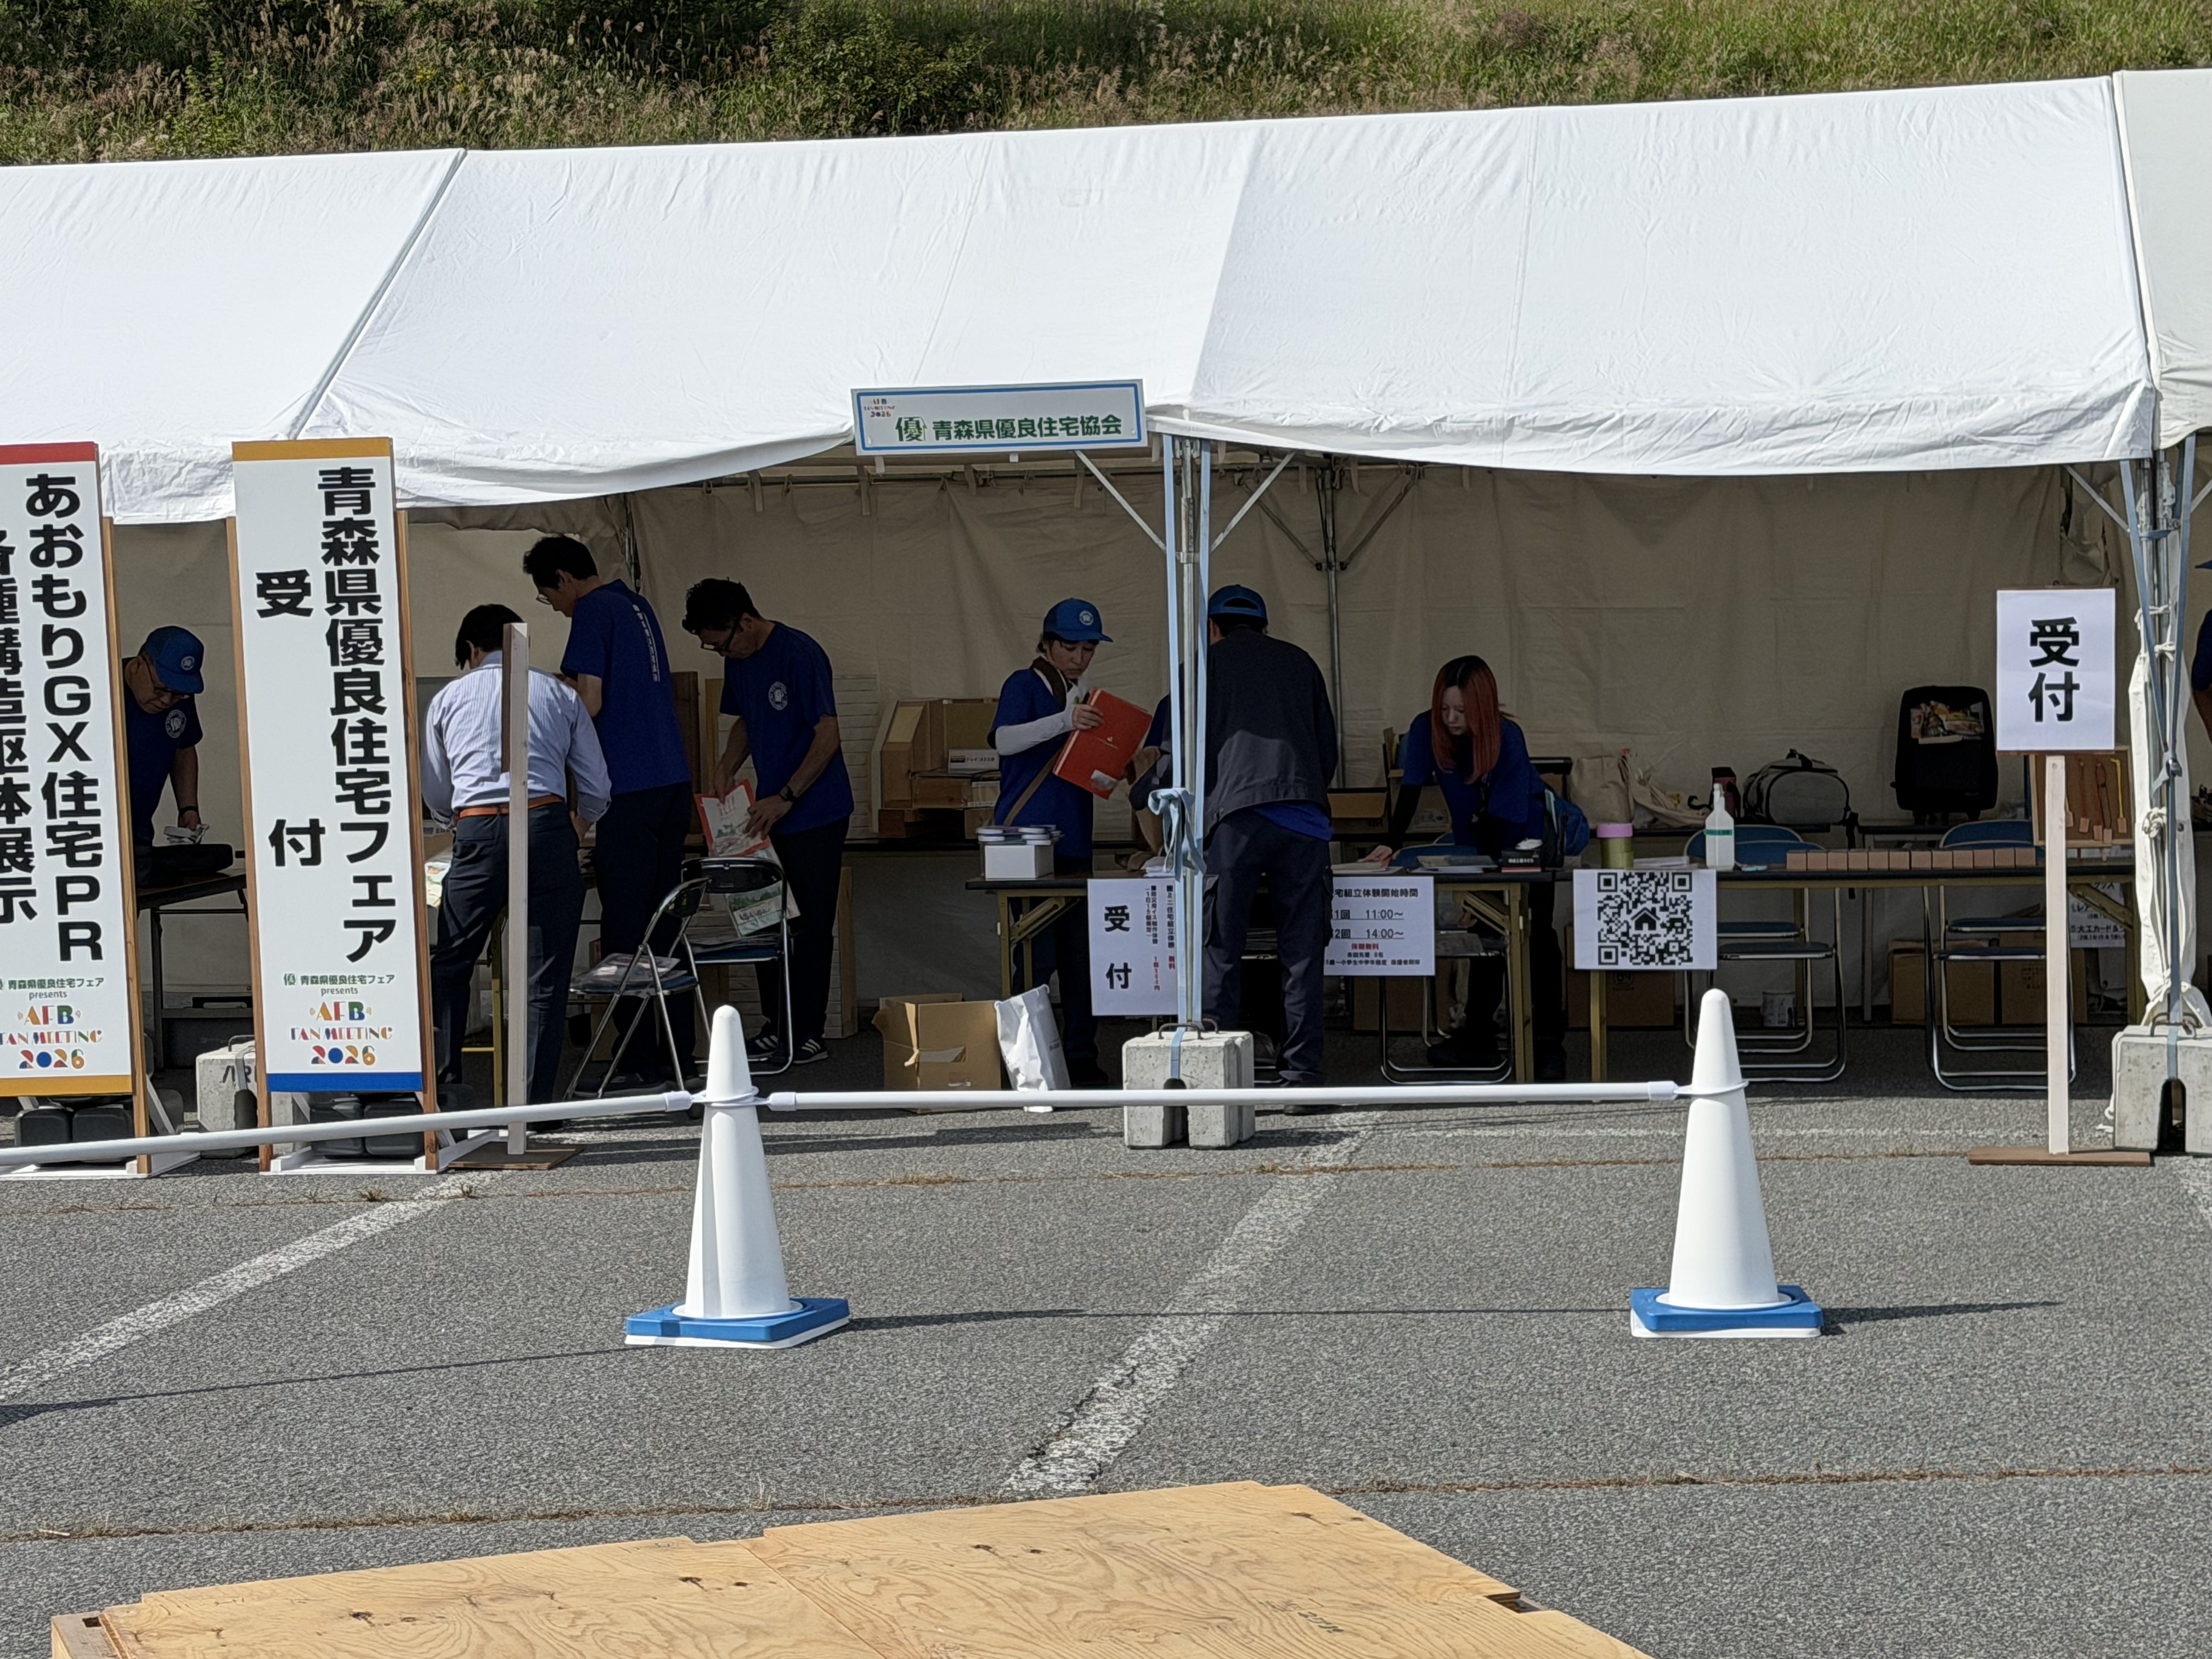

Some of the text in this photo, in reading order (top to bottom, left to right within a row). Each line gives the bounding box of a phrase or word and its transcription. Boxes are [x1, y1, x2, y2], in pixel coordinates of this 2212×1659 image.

[932, 414, 1121, 441] 青森県優良住宅協会
[2029, 616, 2080, 723] 受付
[26, 473, 104, 962] あおもりGX住宅PR
[317, 466, 397, 963] 青森県優良住宅フェア
[0, 530, 38, 924] 躯体展示
[1333, 888, 1419, 898] 宅組立体験開始時間
[1332, 909, 1351, 919] 1回
[1332, 929, 1351, 939] 2回
[8, 978, 104, 990] 青森県優良住宅フェア
[300, 974, 395, 986] 青森県優良住宅フェア
[29, 991, 67, 1001] presents
[321, 986, 359, 997] presents
[24, 1005, 75, 1025] AFB
[316, 1001, 365, 1021] AFB
[32, 1030, 103, 1045] MEETING
[324, 1026, 393, 1040] MEETING
[19, 1048, 85, 1069] 2026
[311, 1045, 376, 1065] 2026
